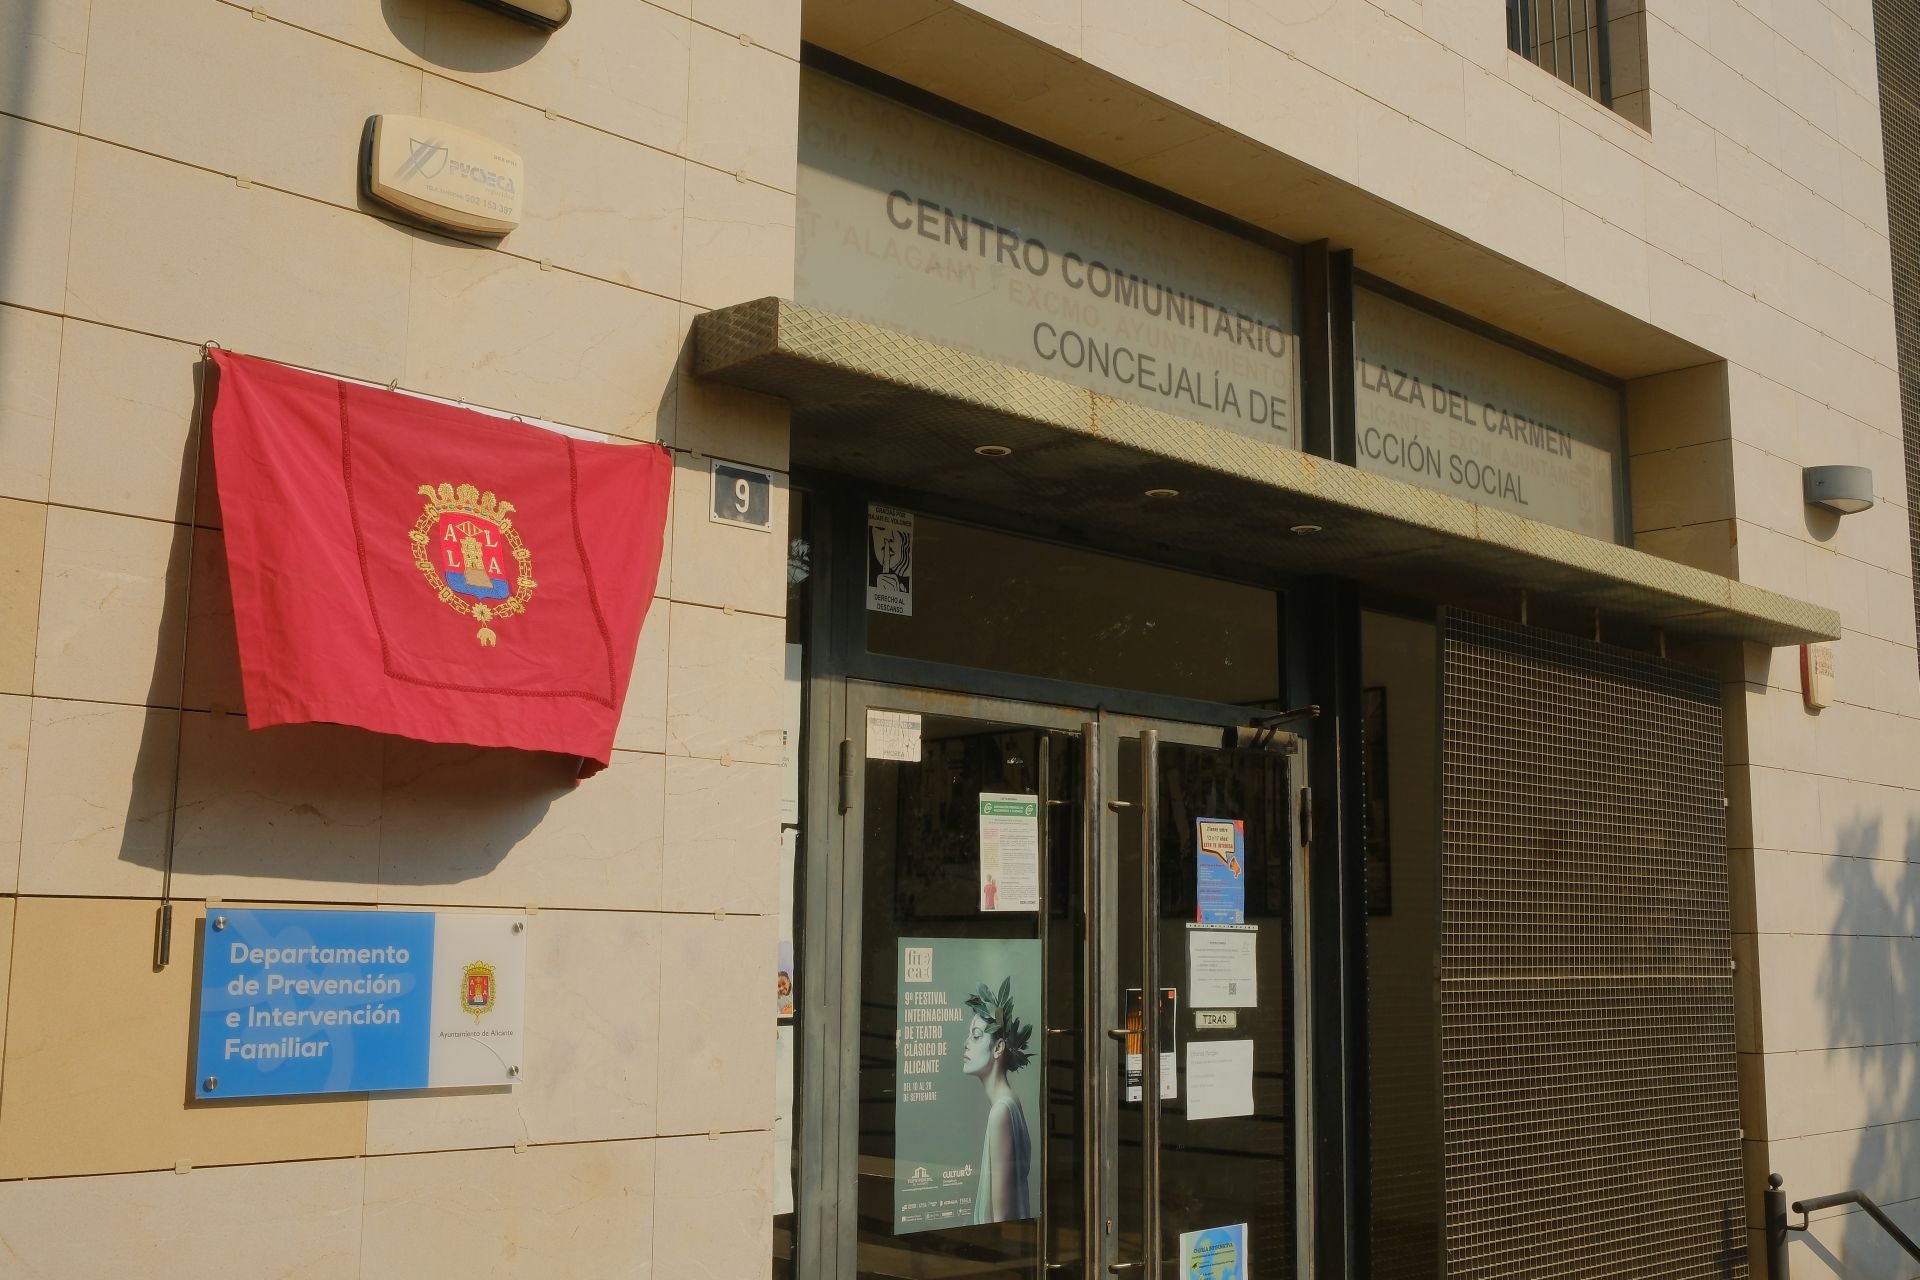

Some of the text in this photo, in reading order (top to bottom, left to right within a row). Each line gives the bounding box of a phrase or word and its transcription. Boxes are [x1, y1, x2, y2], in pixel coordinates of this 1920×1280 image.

[886, 189, 1050, 276] CENTRO
[1062, 251, 1286, 358] COMUNITARIO
[1356, 356, 1426, 409] LAZA
[1432, 382, 1477, 427] DEL
[1482, 403, 1573, 460] CARMEN
[1033, 321, 1242, 419] CONCEJALÍA
[1249, 388, 1288, 433] DE
[1449, 453, 1529, 506] SOCIAL
[735, 478, 750, 513] 9
[444, 523, 498, 548] A L
[446, 550, 502, 575] L A
[874, 593, 898, 604] DERECHO
[877, 603, 904, 614] DESCANSO
[230, 943, 410, 968] Departamento
[228, 973, 401, 996] de Prevención
[904, 991, 948, 1006] 9º FESTIVAL
[225, 1004, 400, 1028] e Intervención
[904, 1008, 963, 1022] INTERNACIONAL
[1202, 1014, 1227, 1025] TIRAR
[439, 1029, 514, 1040] Ayuntamiento de Alicante
[904, 1025, 943, 1040] DE TEATRO
[225, 1038, 329, 1060] Familiar
[904, 1040, 948, 1057] CLÁSICO DE
[903, 1059, 940, 1074] ALICANTE
